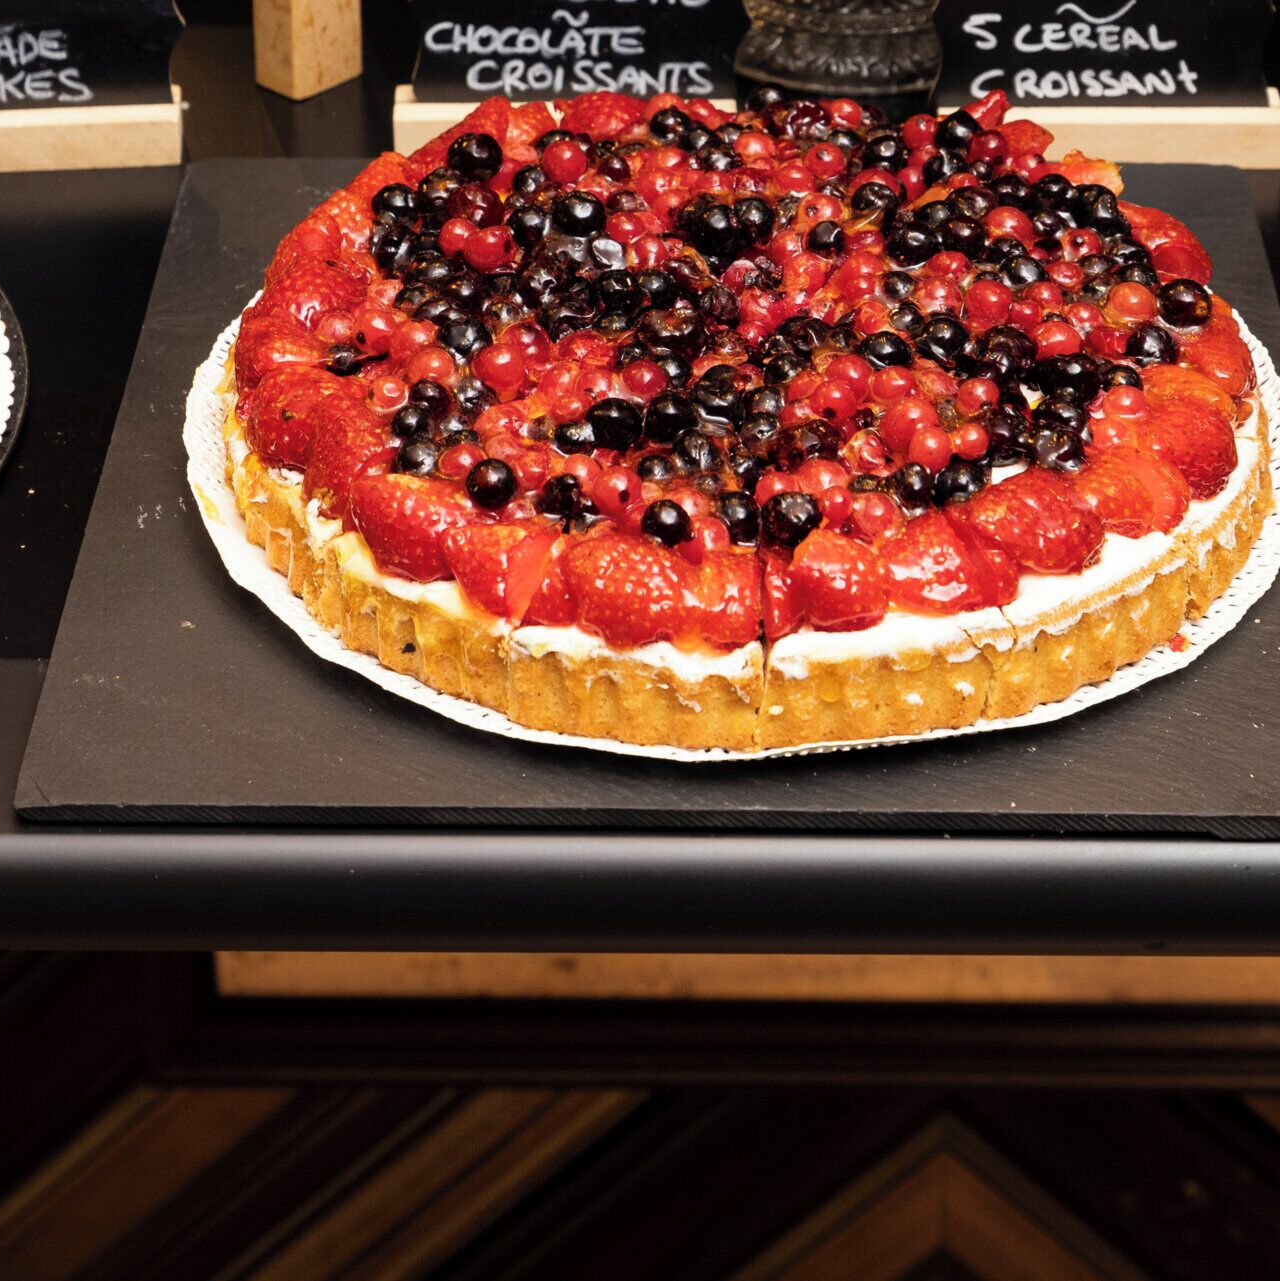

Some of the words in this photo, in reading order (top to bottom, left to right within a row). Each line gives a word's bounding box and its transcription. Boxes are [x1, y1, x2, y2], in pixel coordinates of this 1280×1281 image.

[424, 22, 645, 57] CHOCOLATE
[1014, 24, 1177, 52] CEREAL
[466, 60, 714, 95] CROISSANTS
